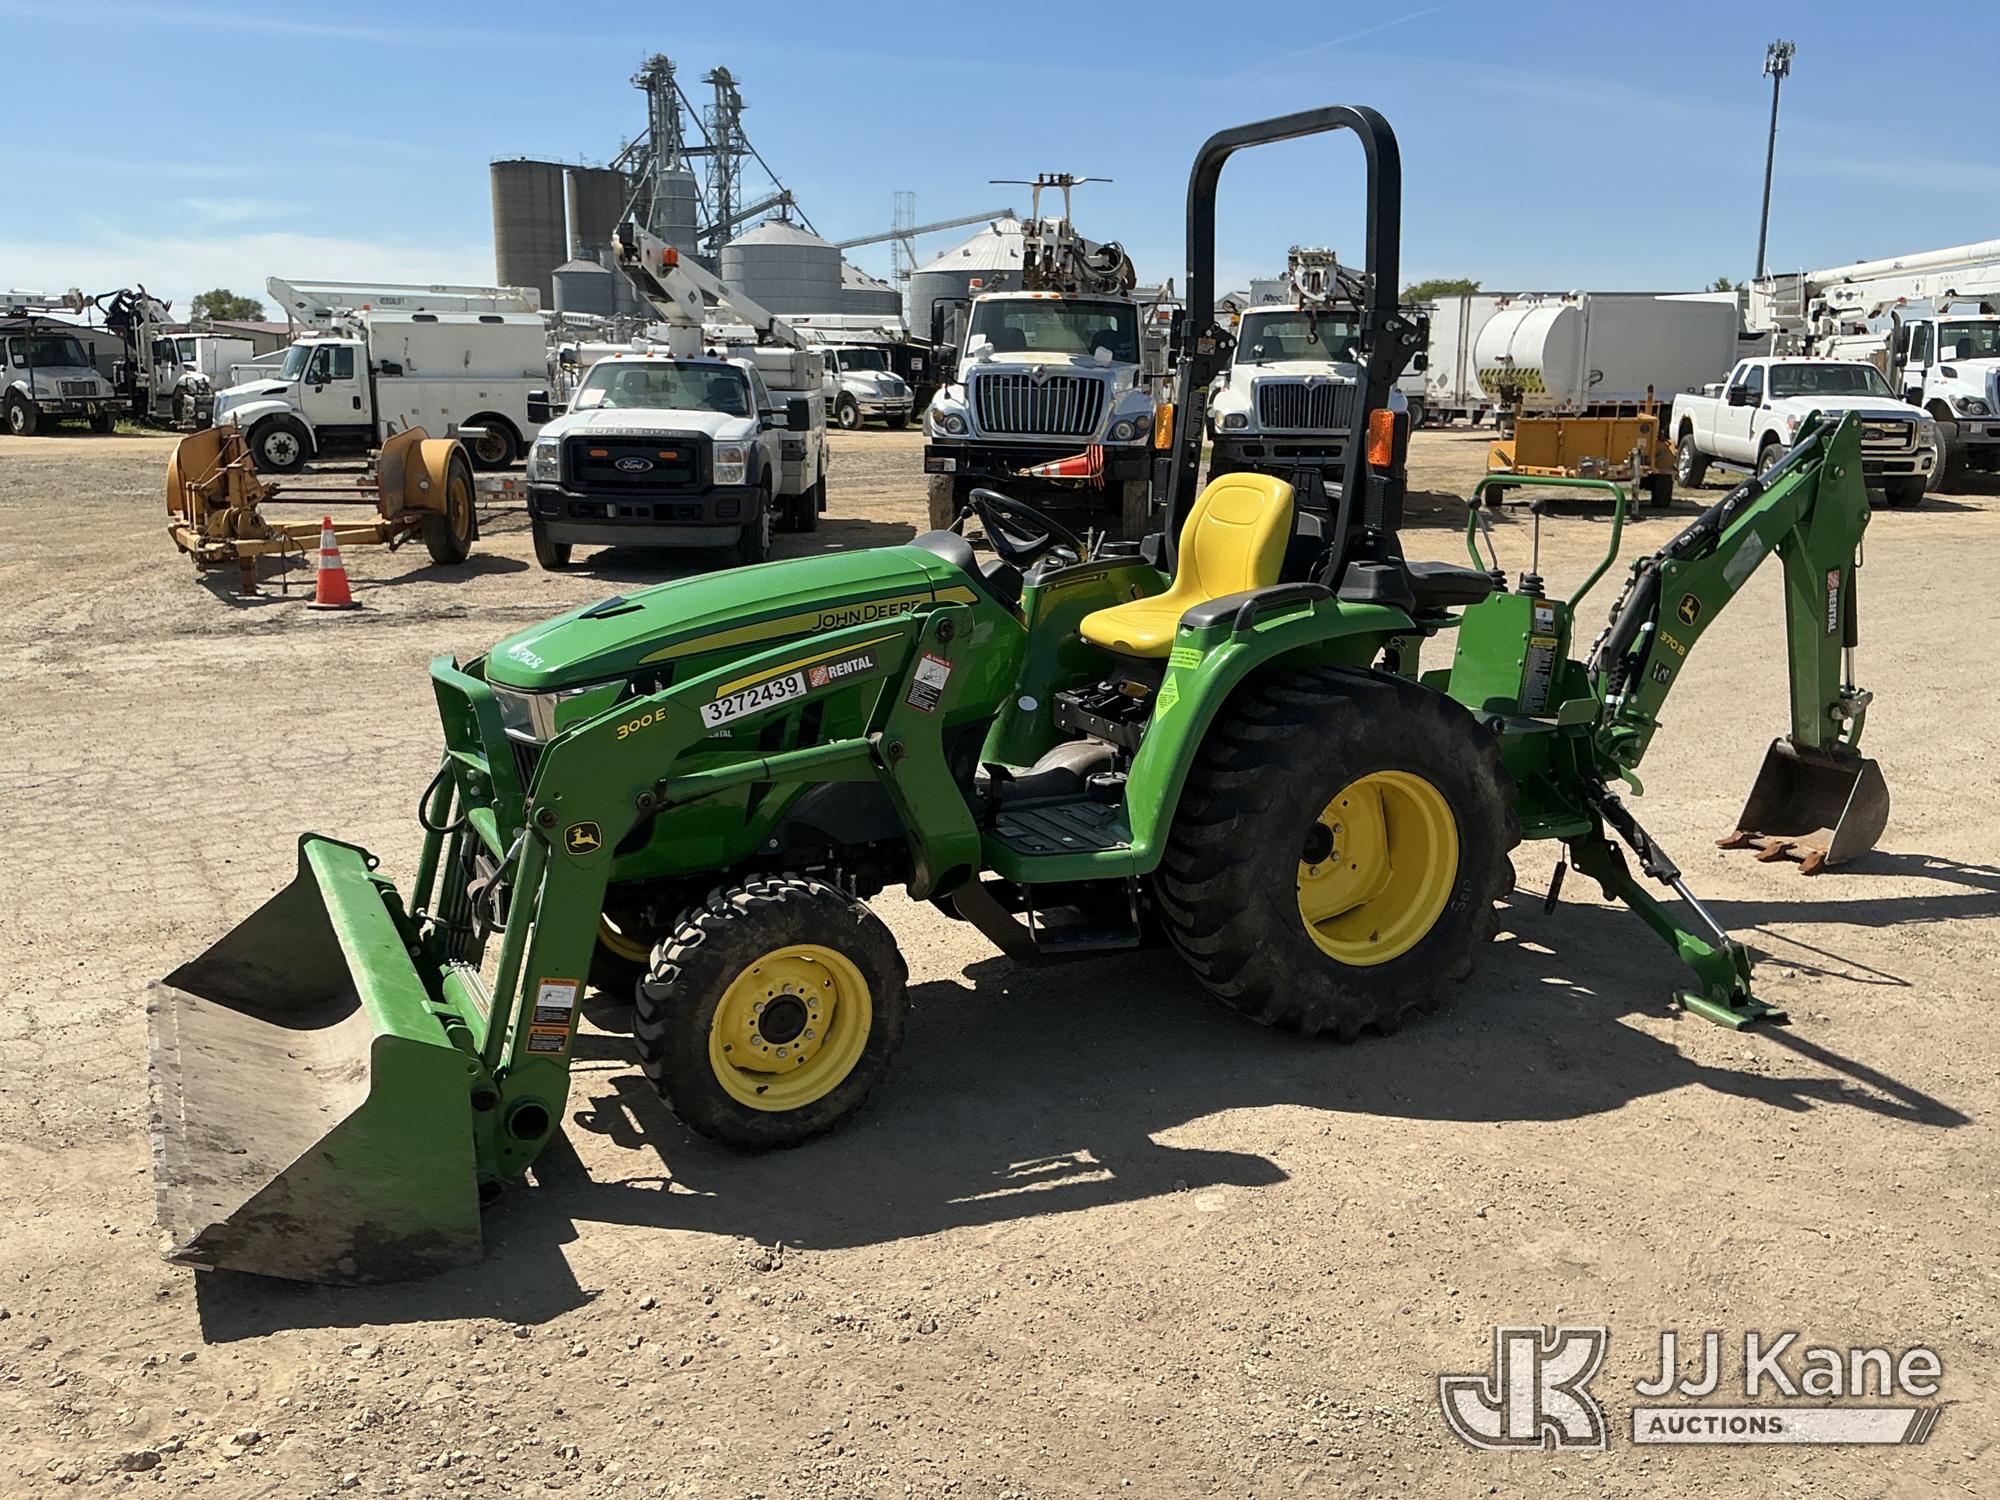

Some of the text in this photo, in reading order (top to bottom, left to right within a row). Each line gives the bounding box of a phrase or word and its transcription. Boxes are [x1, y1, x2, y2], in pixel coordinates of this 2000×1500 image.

[1262, 293, 1284, 303] Altec
[622, 460, 644, 470] Ford
[811, 609, 861, 631] JOHN
[828, 655, 874, 680] RENTAL
[708, 675, 799, 722] 3272439
